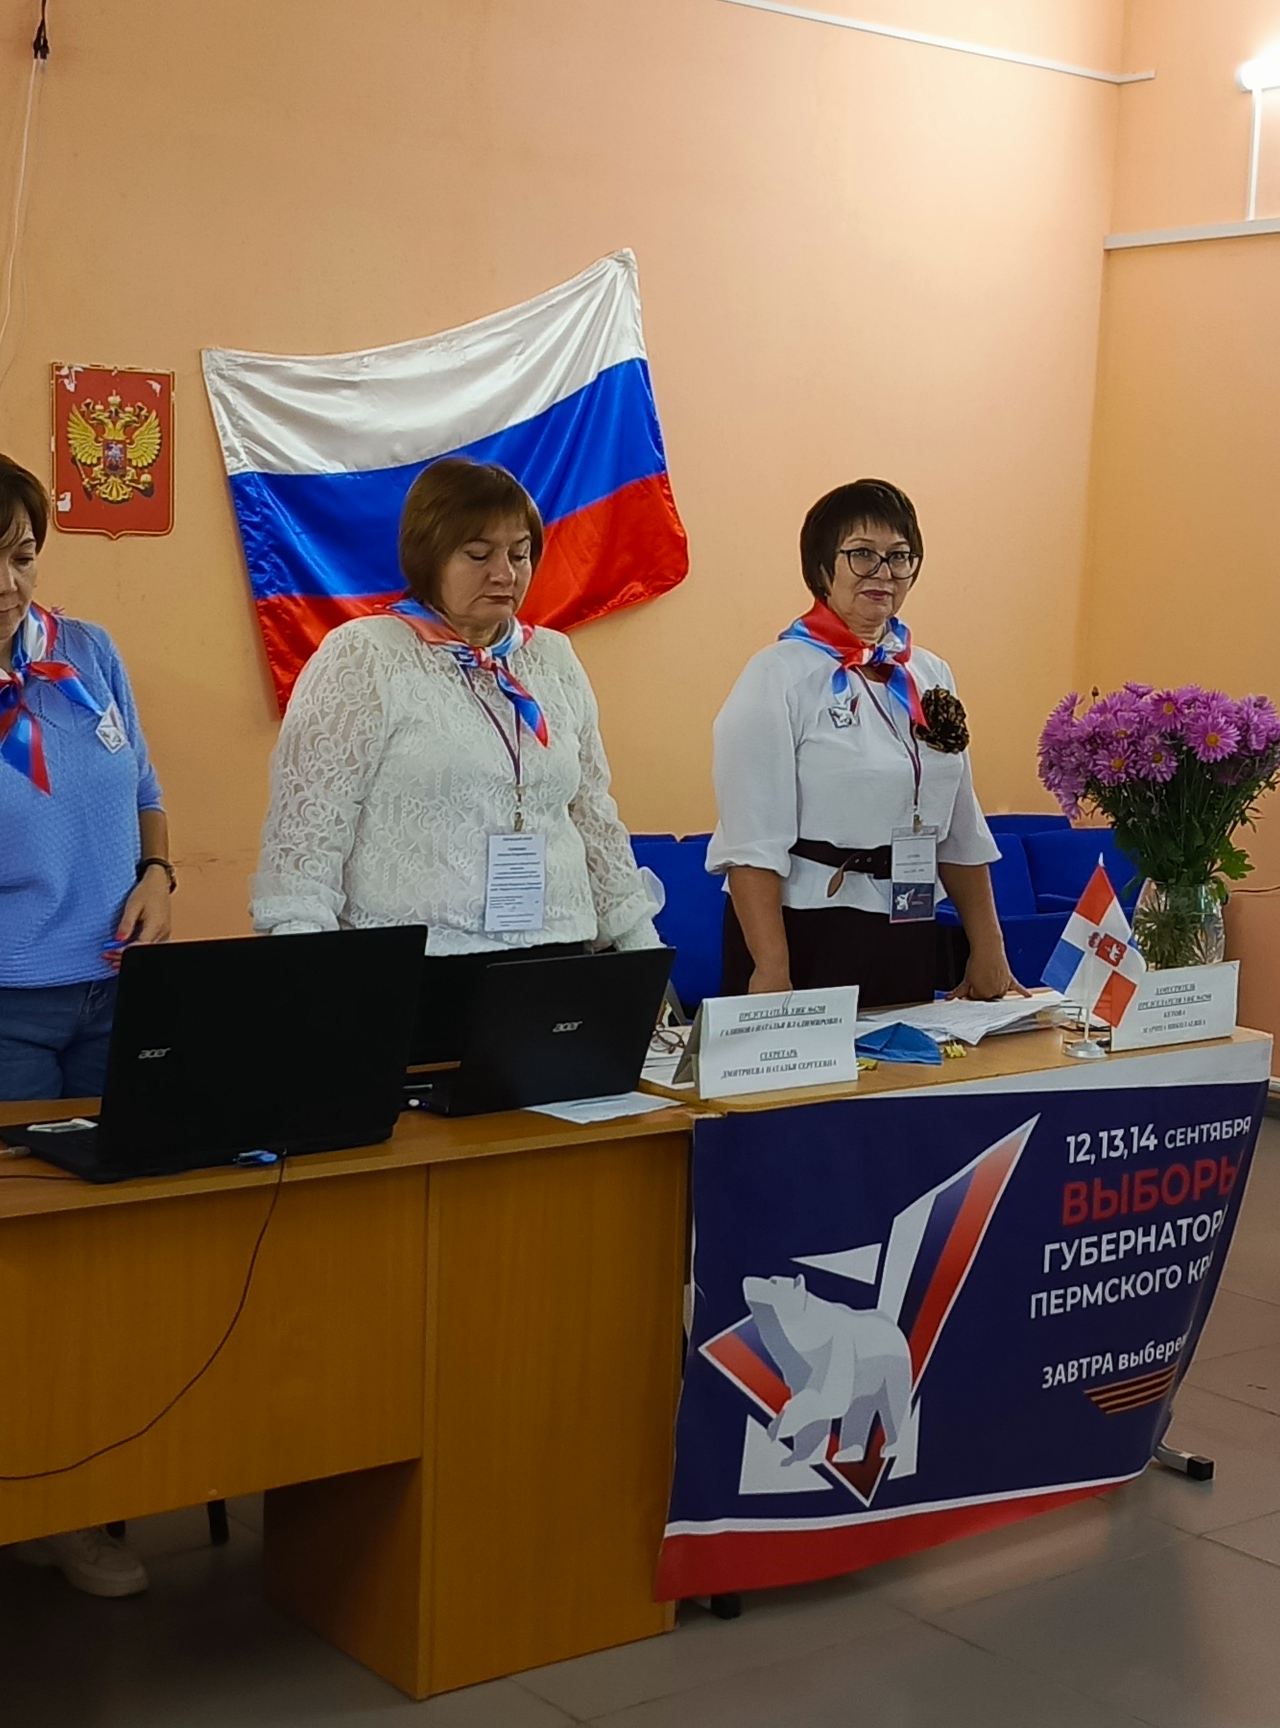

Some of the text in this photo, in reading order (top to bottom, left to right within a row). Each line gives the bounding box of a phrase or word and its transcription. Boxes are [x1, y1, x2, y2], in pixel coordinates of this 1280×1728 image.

[553, 1020, 583, 1033] acer
[138, 1047, 172, 1060] acer
[1066, 1115, 1252, 1165] 12,13,14 СЕНТЯБРЯ
[1043, 1204, 1228, 1274] ГУБЕРНАТОР
[1030, 1263, 1182, 1320] ПЕРМСКОГО
[1041, 1352, 1114, 1390] ЗАВТРА
